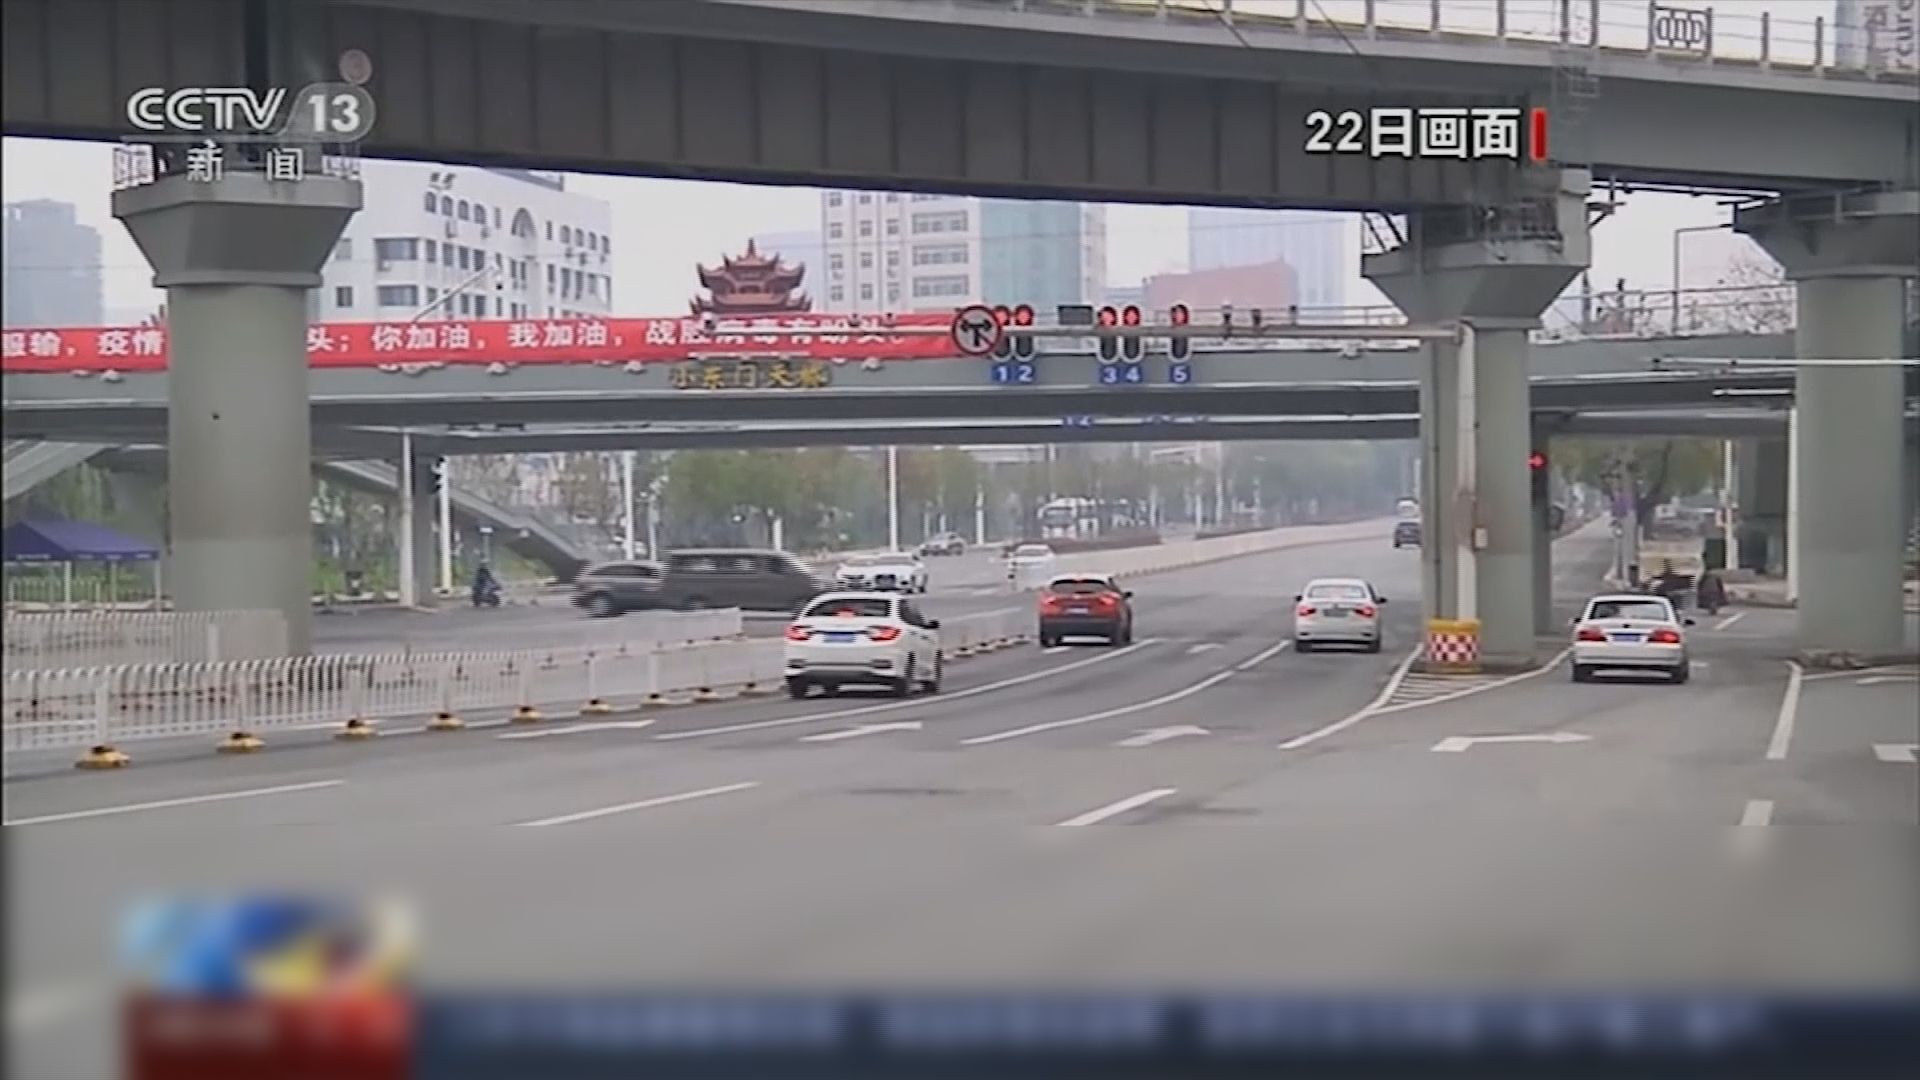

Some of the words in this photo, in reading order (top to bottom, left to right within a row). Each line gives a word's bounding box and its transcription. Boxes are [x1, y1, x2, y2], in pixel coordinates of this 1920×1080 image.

[1017, 366, 1033, 382] 2
[1103, 367, 1117, 383] 3
[1125, 366, 1140, 382] 4
[1173, 366, 1188, 382] 5
